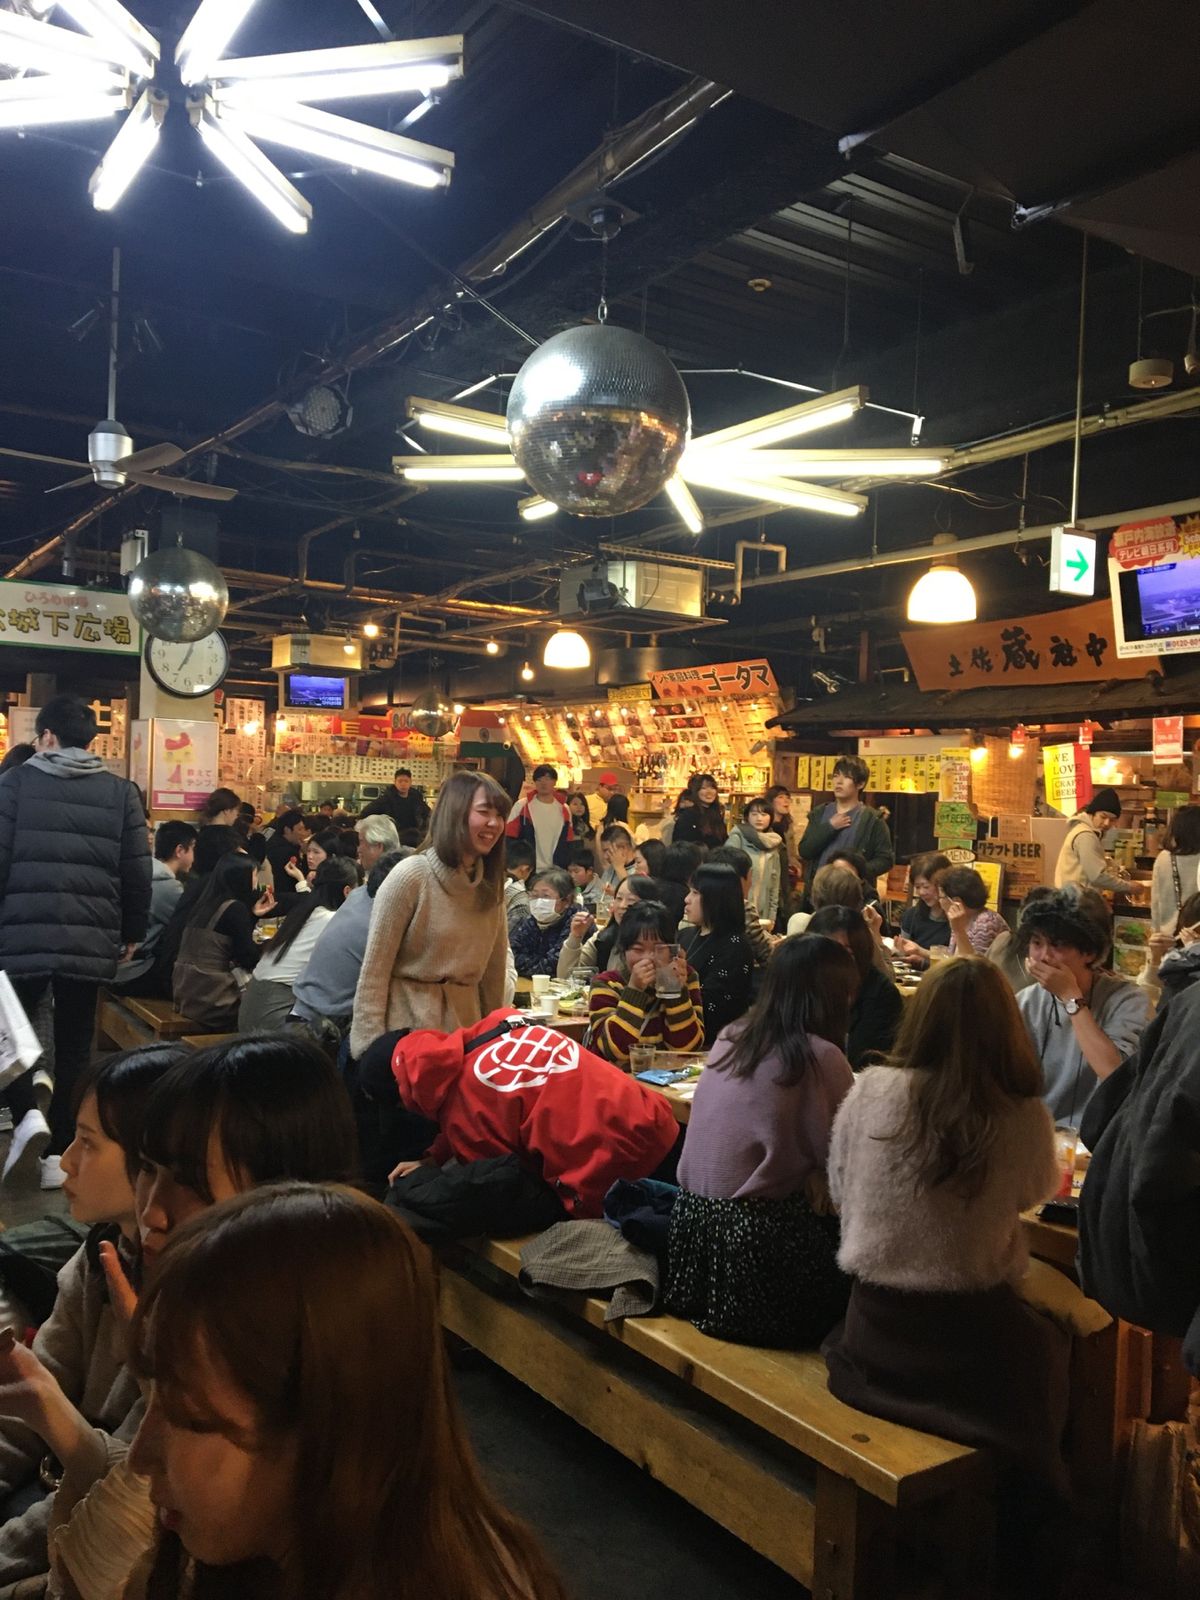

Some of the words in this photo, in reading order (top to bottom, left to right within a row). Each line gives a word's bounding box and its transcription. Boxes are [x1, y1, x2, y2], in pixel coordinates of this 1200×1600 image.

[1119, 540, 1175, 560] テレビ朝日系列
[24, 590, 89, 609] ひろめ市場
[0, 607, 131, 645] 城下広場
[701, 664, 770, 693] ゴータマ
[1053, 752, 1070, 763] WE
[1052, 763, 1083, 776] LOVE
[1054, 778, 1081, 789] CRAFT
[1055, 787, 1078, 797] BEER
[944, 849, 972, 861] MENU
[978, 842, 1011, 857] クラフト
[1013, 843, 1041, 858] BEER
